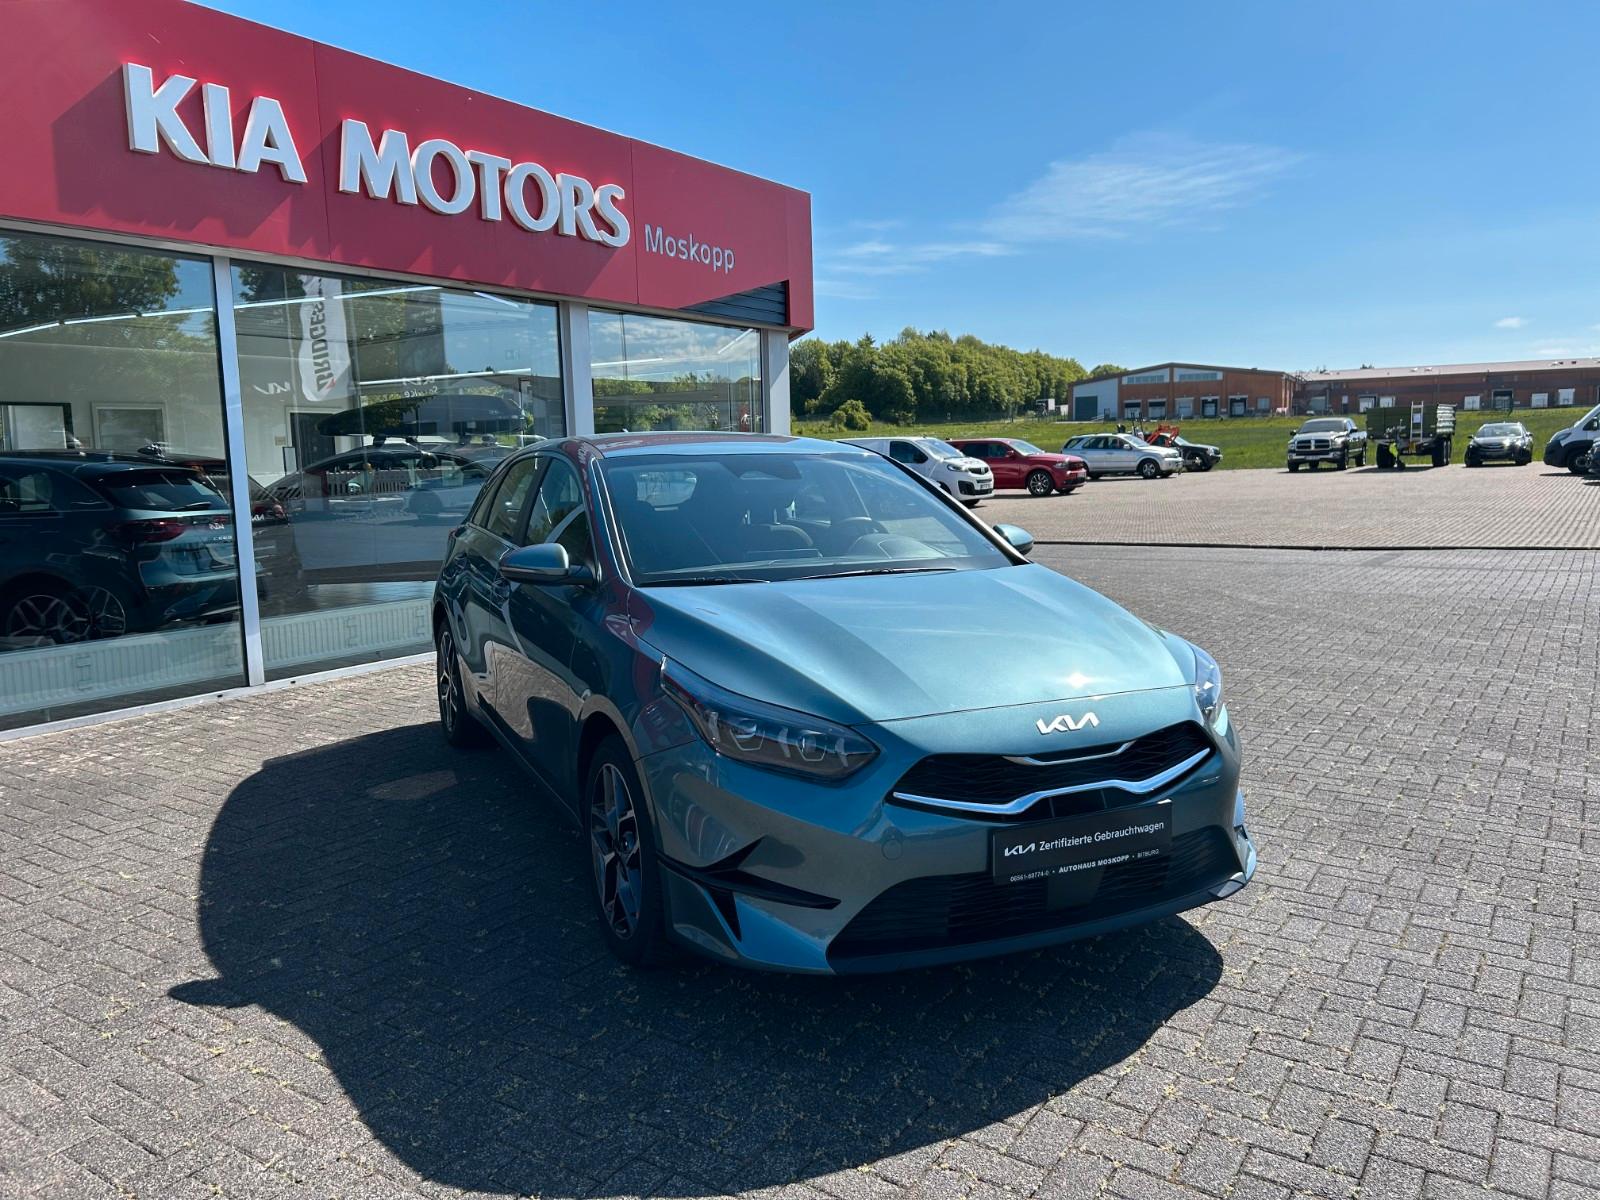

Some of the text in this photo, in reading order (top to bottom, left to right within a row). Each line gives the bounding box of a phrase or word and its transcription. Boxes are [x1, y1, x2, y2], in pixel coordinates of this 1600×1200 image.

[123, 62, 631, 249] KIA MOTORS
[645, 223, 736, 274] Moskopp
[1035, 712, 1100, 735] KIA
[1004, 821, 1165, 856] KIA Zertifizierte Gebrauchtwagen
[1058, 861, 1096, 874] AUTOHAUS
[1097, 854, 1130, 866] MOSKOPP
